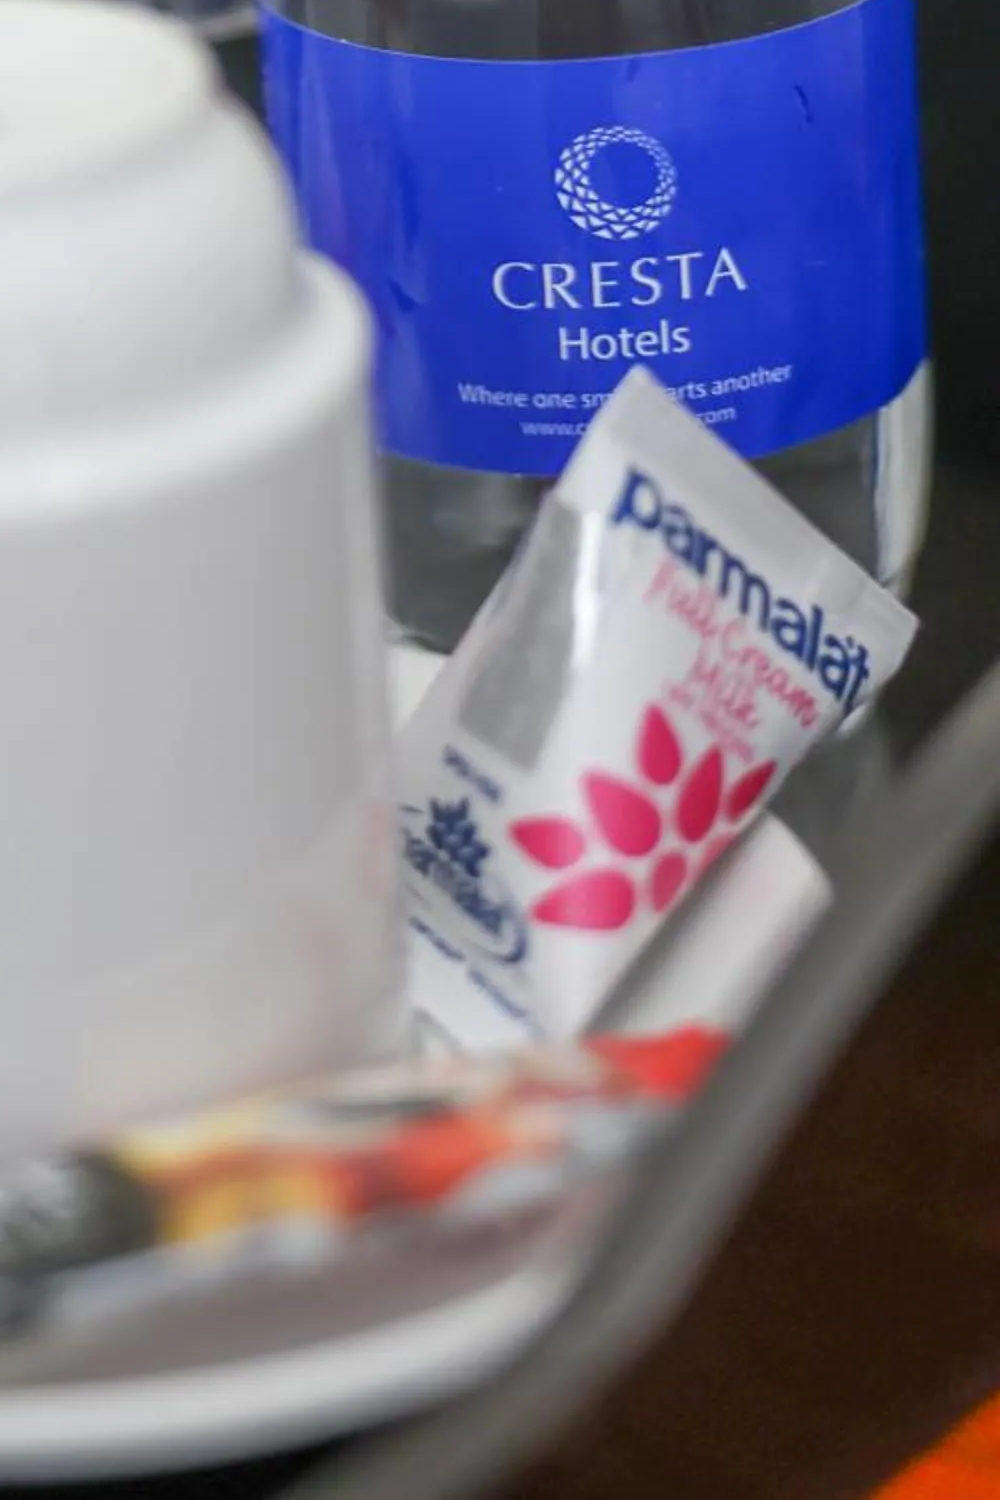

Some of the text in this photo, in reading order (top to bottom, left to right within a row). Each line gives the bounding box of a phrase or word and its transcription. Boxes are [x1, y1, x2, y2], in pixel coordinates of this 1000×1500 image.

[492, 247, 748, 309] CRESTA
[558, 319, 692, 360] Hotels
[457, 380, 530, 408] Where
[532, 392, 577, 409] one
[711, 364, 793, 396] another
[611, 466, 870, 713] parmalat
